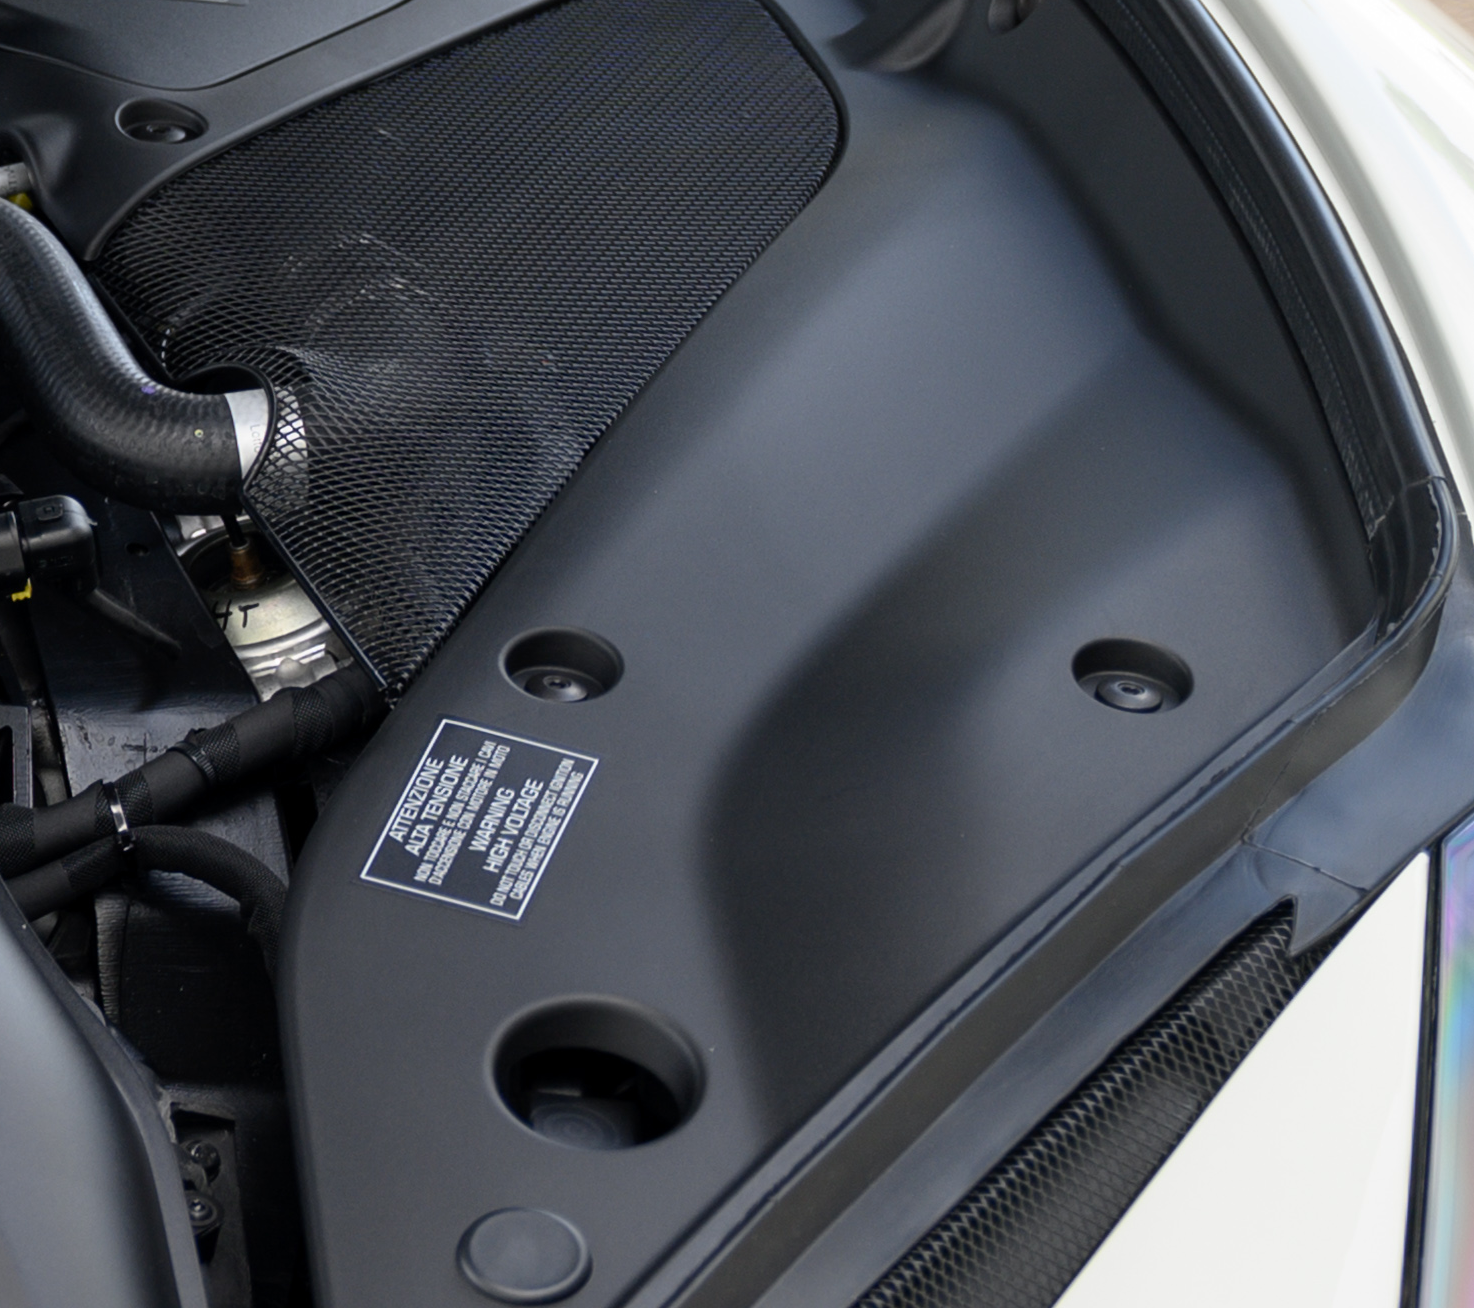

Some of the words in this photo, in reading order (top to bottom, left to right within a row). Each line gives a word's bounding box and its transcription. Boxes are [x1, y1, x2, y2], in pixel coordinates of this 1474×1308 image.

[212, 599, 259, 631] HT
[385, 755, 446, 842] ATTENZIONE
[401, 821, 435, 857] ALTA
[419, 753, 470, 823] TENSIONE
[467, 786, 516, 853] WARNING
[481, 836, 515, 873] HIGH
[499, 777, 545, 837] VOLTAGE
